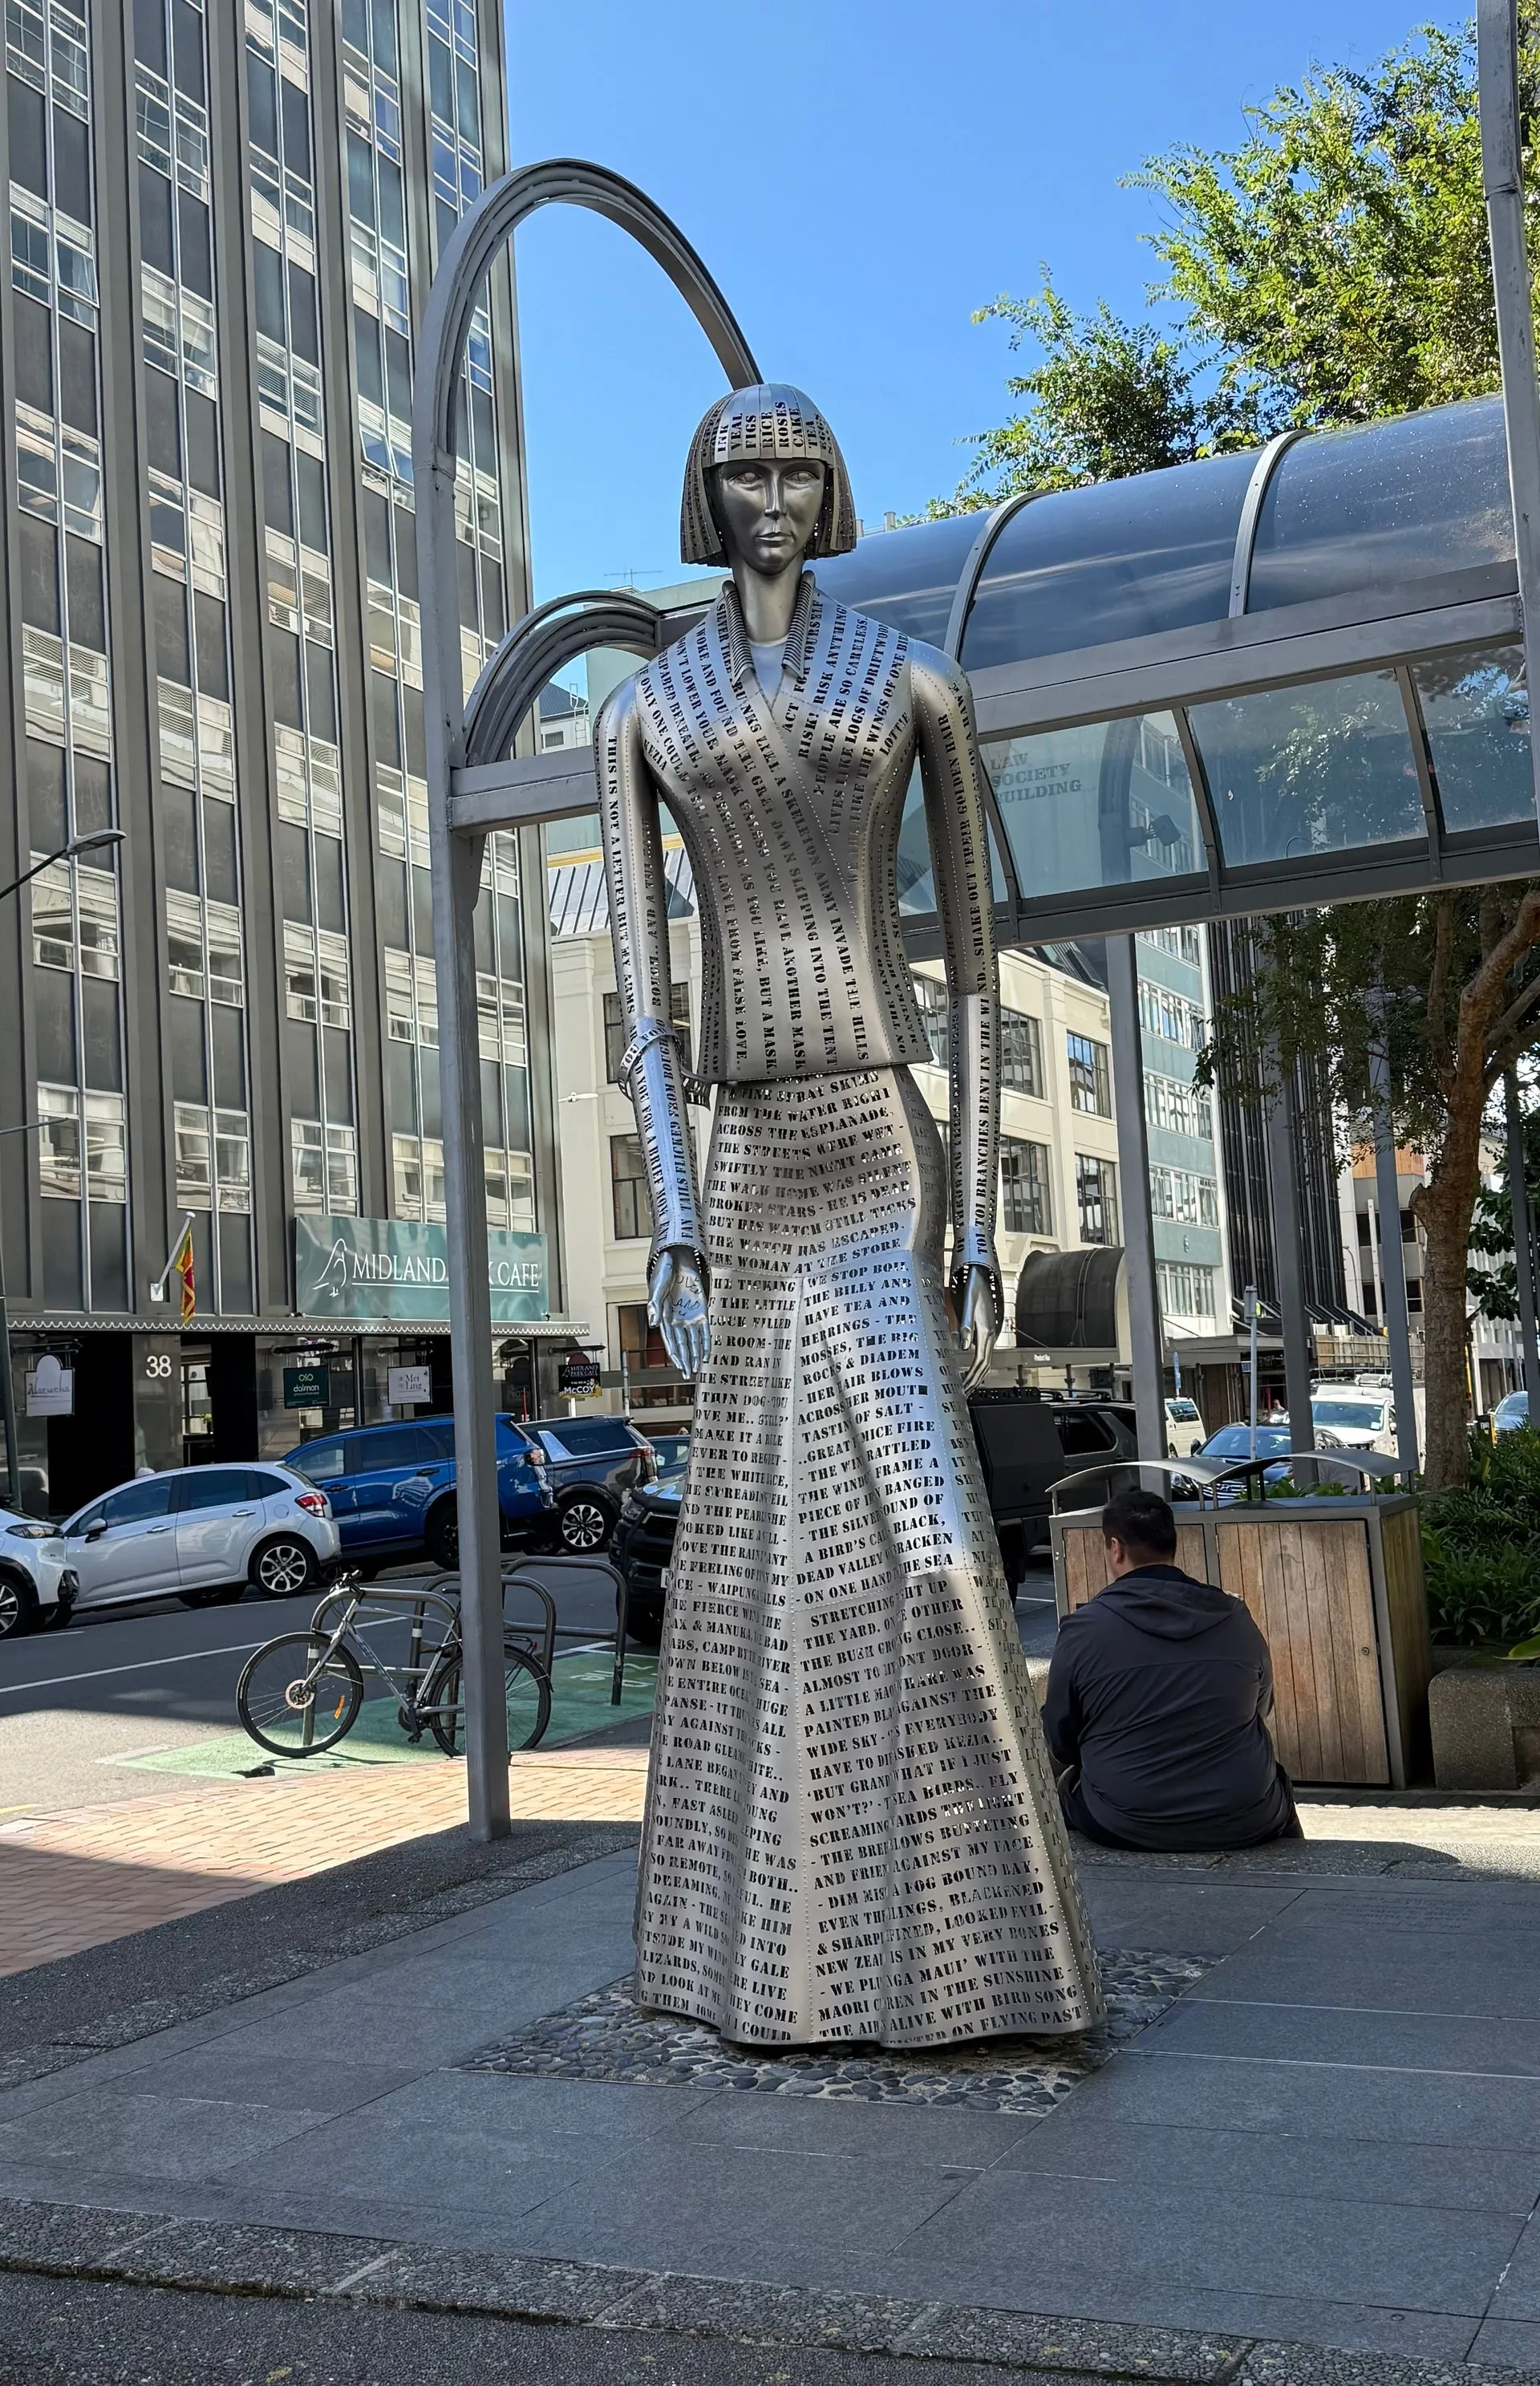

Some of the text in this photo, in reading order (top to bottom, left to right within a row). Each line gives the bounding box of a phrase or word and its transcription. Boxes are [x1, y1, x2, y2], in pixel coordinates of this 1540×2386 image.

[718, 424, 728, 452] INK
[731, 413, 743, 451] VEAL
[746, 416, 756, 448] FIGS
[761, 412, 773, 448] RICE
[776, 402, 789, 448] ROSES
[789, 408, 804, 448] CAKE
[805, 421, 817, 448] TEA
[641, 676, 669, 736] ONLY ONE
[829, 680, 853, 729] ARE SO
[866, 654, 906, 744] WINGS OF ONE
[782, 703, 800, 732] ACT
[798, 672, 834, 759] RISK! RISK
[845, 687, 872, 745] LOGS OF
[879, 712, 911, 757] LOTTIE
[642, 739, 668, 771] KEZIA
[990, 753, 1028, 770] LAW
[991, 762, 1071, 787] SOCIETY
[696, 628, 839, 1066] WOKE AND INTO THE TENT
[681, 668, 806, 1070] LOWER ANOTHER MASK
[646, 907, 658, 939] AND
[608, 736, 664, 1183] THIS IS NOT LETTER BUT ARMS FOR BRIEF
[758, 976, 773, 1008] BUT
[830, 918, 869, 1061] INVADE HILLS
[938, 713, 991, 1256] TOI TOI BRANCHES BENT IN THE SHAKE OUT GOLDEN HAIR
[716, 1106, 894, 1141] ACROSS THE ESPLANADE.
[718, 1102, 838, 1122] FROM WATER
[665, 1085, 694, 1239] FAN TAILS FLICKED FROM
[718, 1142, 811, 1160] THE STREETS
[713, 1155, 856, 1179] SWIFTLY THE NIGHT
[707, 1175, 854, 1198] THE WALK WAS
[709, 1188, 867, 1218] BROKEN STARS IS
[768, 1197, 916, 1237] WATCH STILL TICKS
[352, 1253, 447, 1282] MIDLAND
[496, 1261, 540, 1288] CAFE
[737, 1239, 901, 1274] WOMAN AT STORE
[738, 1278, 796, 1292] TICKING
[831, 1266, 869, 1283] STOP
[833, 1276, 913, 1300] BILLY AND
[719, 1297, 796, 1312] THE LITTLE
[804, 1296, 911, 1325] HAVE TEA AND
[726, 1336, 766, 1349] ROOM
[801, 1318, 871, 1349] HERRINGS
[146, 1355, 172, 1378] 38
[800, 1341, 852, 1368] MOSSES,
[860, 1348, 920, 1366] DIADEM
[871, 1366, 924, 1382] BLOWS
[797, 1384, 929, 1426] ACROSS MOUTH
[695, 1428, 752, 1443] MAKE IT
[897, 1421, 935, 1434] FIRE
[866, 1438, 932, 1461] RATTLED
[875, 1458, 923, 1479] FRAME
[798, 1475, 945, 1524] PIECE BANGED
[818, 1514, 946, 1560] BIRD'S BLACK,
[796, 1568, 835, 1585] DEAD
[829, 1553, 954, 1598] ONE SEA
[839, 1598, 965, 1642] YARD. OTHER
[917, 1622, 976, 1641] CLOSE..
[701, 1660, 740, 1678] BELOW
[802, 1671, 861, 1695] ALMOST
[820, 1690, 871, 1713] LITTLE
[804, 1711, 870, 1738] PAINTED
[906, 1708, 999, 1736] EVERYBODY
[667, 1755, 703, 1771] LANE
[967, 1836, 1034, 1856] MY FACE
[669, 1854, 799, 1893] REMOTE, BOTH..
[828, 1864, 999, 1910] DIM BOUND
[948, 1881, 1044, 1907] BLACKENED
[760, 1917, 792, 1937] HIM
[943, 1905, 1009, 1930] LOOKED
[749, 1933, 788, 1957] INTO
[642, 1949, 787, 2001] LIZARDS, LIVE
[751, 1958, 790, 1979] GALE
[983, 1967, 1065, 1988] SUNSHINE
[652, 1991, 792, 2041] THEM COULD
[753, 2003, 798, 2024] COME
[889, 1984, 1078, 2031] ALIVE BIRD SONG
[980, 2004, 1084, 2031] FLYING PAST
